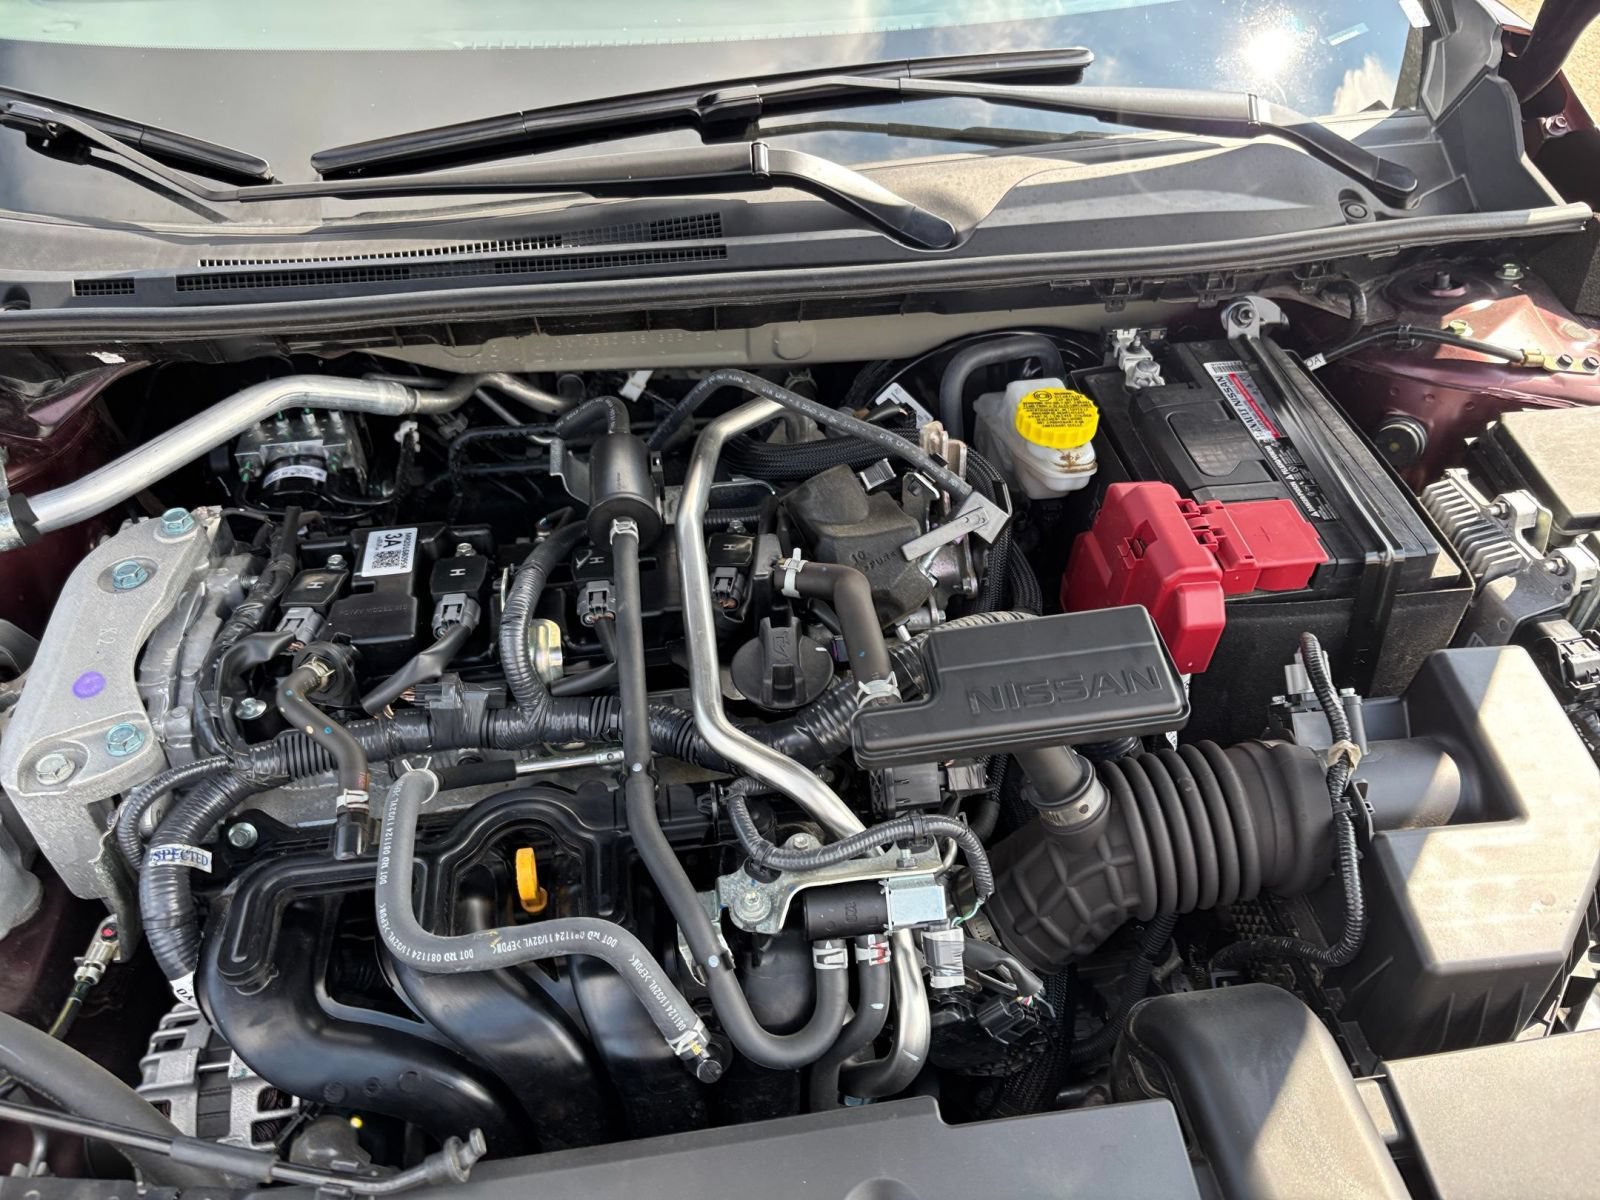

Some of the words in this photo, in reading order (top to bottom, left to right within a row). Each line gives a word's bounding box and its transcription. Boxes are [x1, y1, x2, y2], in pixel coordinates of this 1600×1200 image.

[1216, 375, 1243, 407] NISSAN
[383, 533, 403, 548] 3A
[967, 665, 1164, 715] NISSAN
